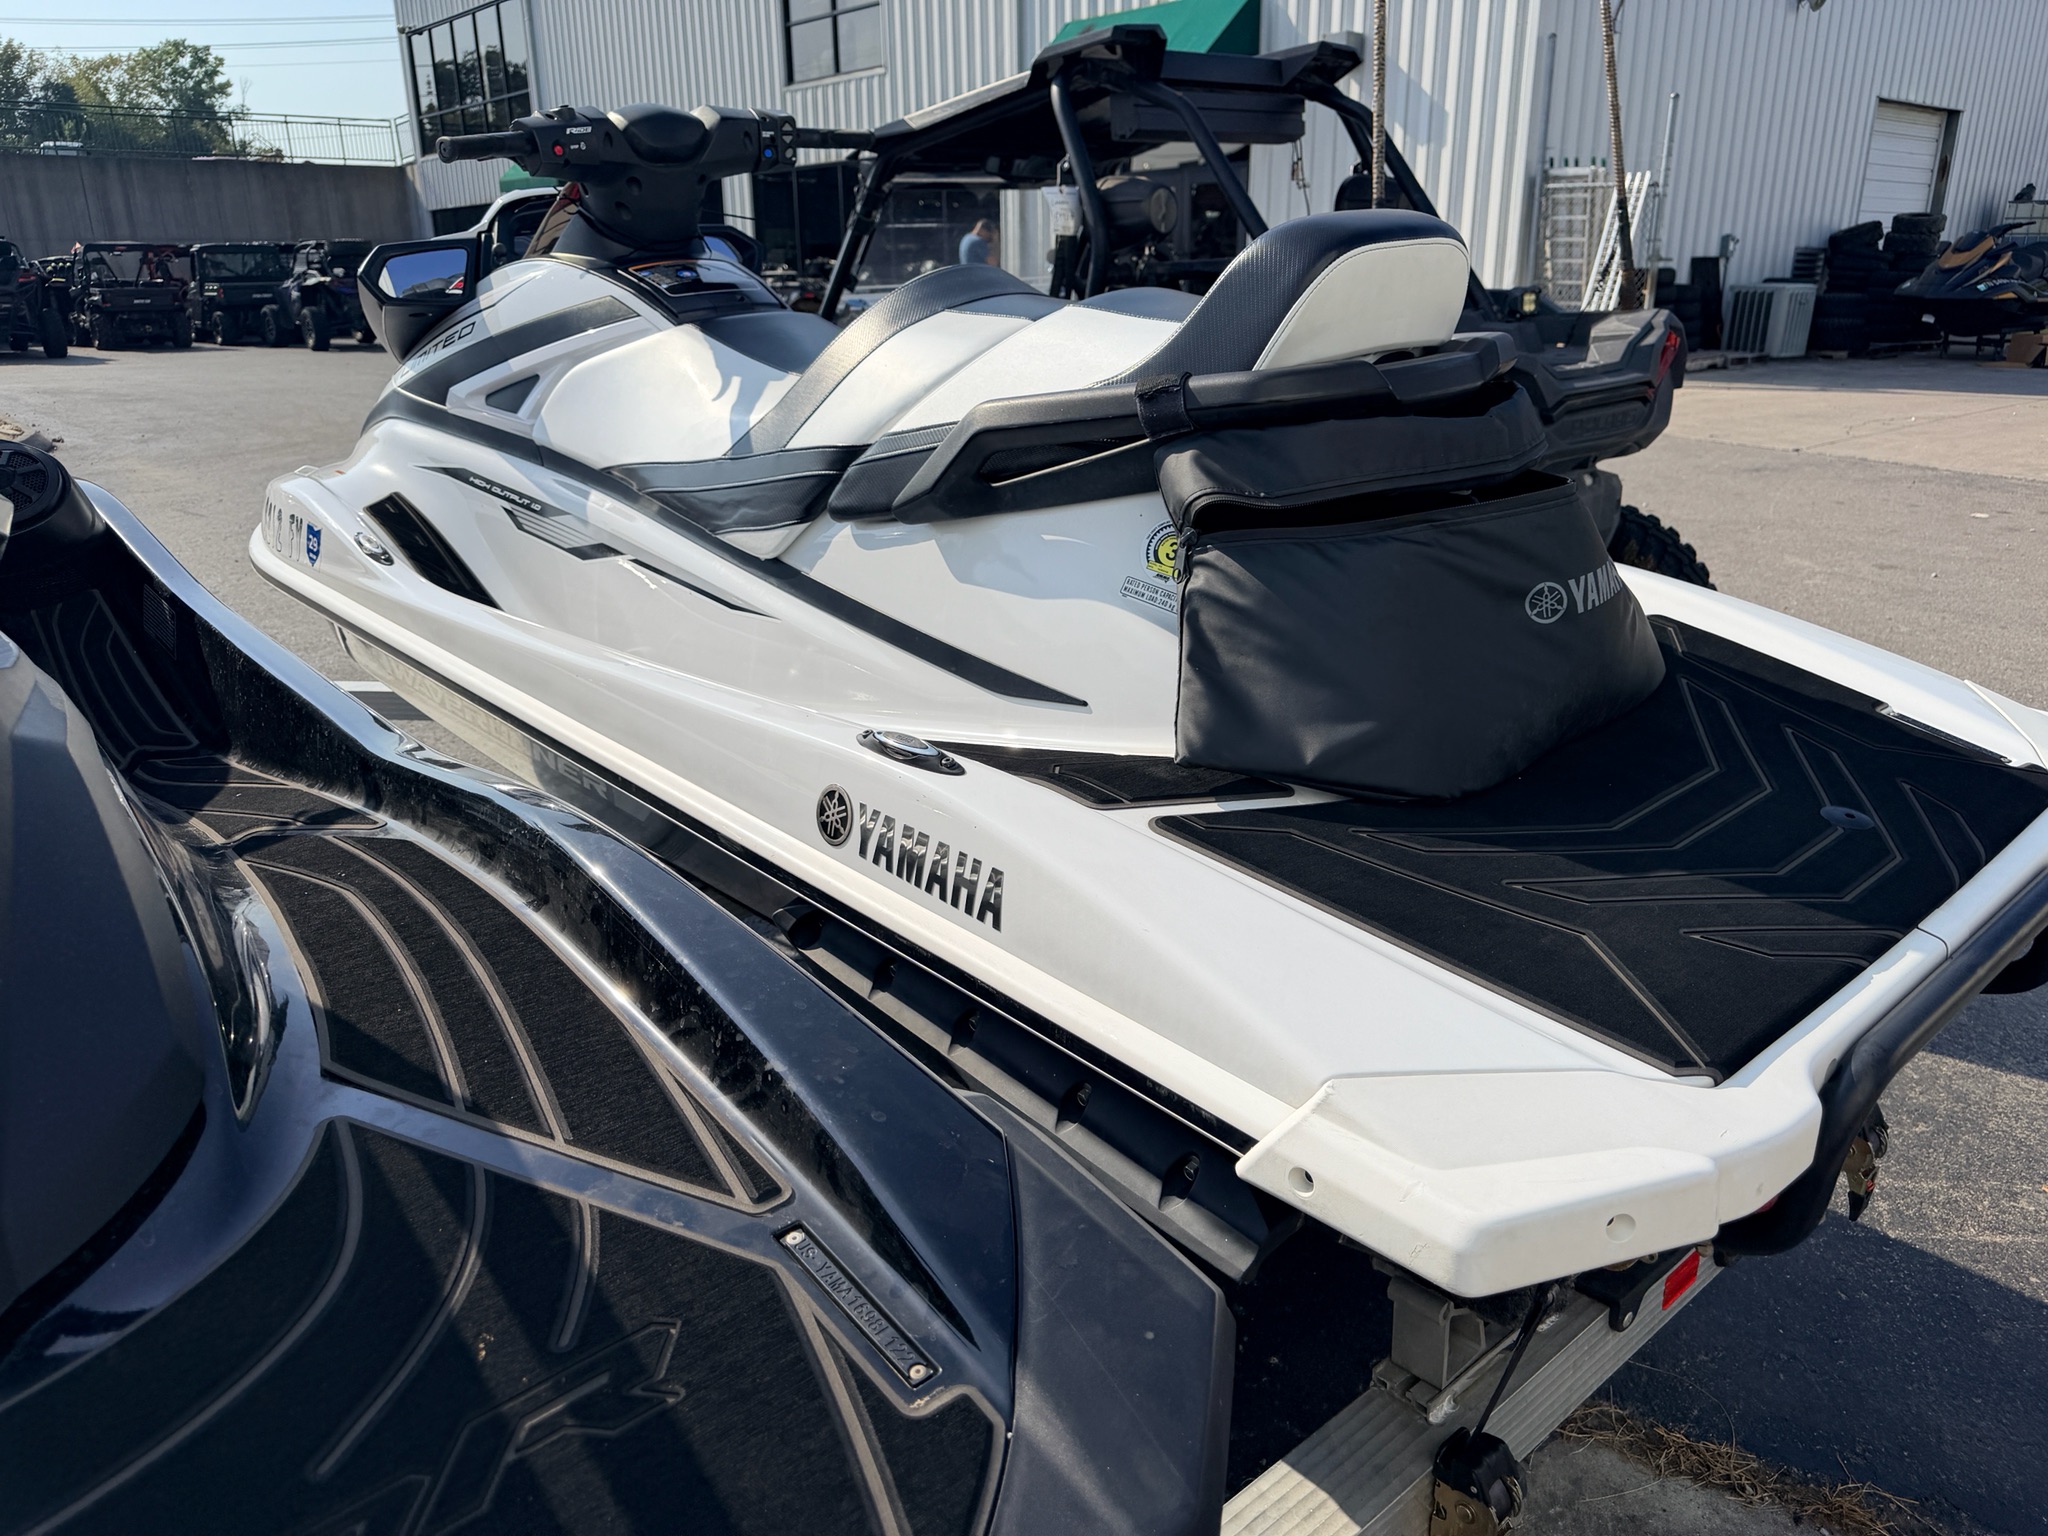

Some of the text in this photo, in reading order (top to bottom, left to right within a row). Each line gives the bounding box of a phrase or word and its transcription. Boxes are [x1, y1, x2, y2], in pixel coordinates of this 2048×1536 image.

[491, 486, 530, 506] OUTPUT
[308, 534, 319, 552] 29
[1126, 578, 1141, 589] RATED
[1140, 583, 1159, 596] PERSON
[1567, 560, 1623, 614] YAMAH
[858, 801, 1004, 934] YAMAHA
